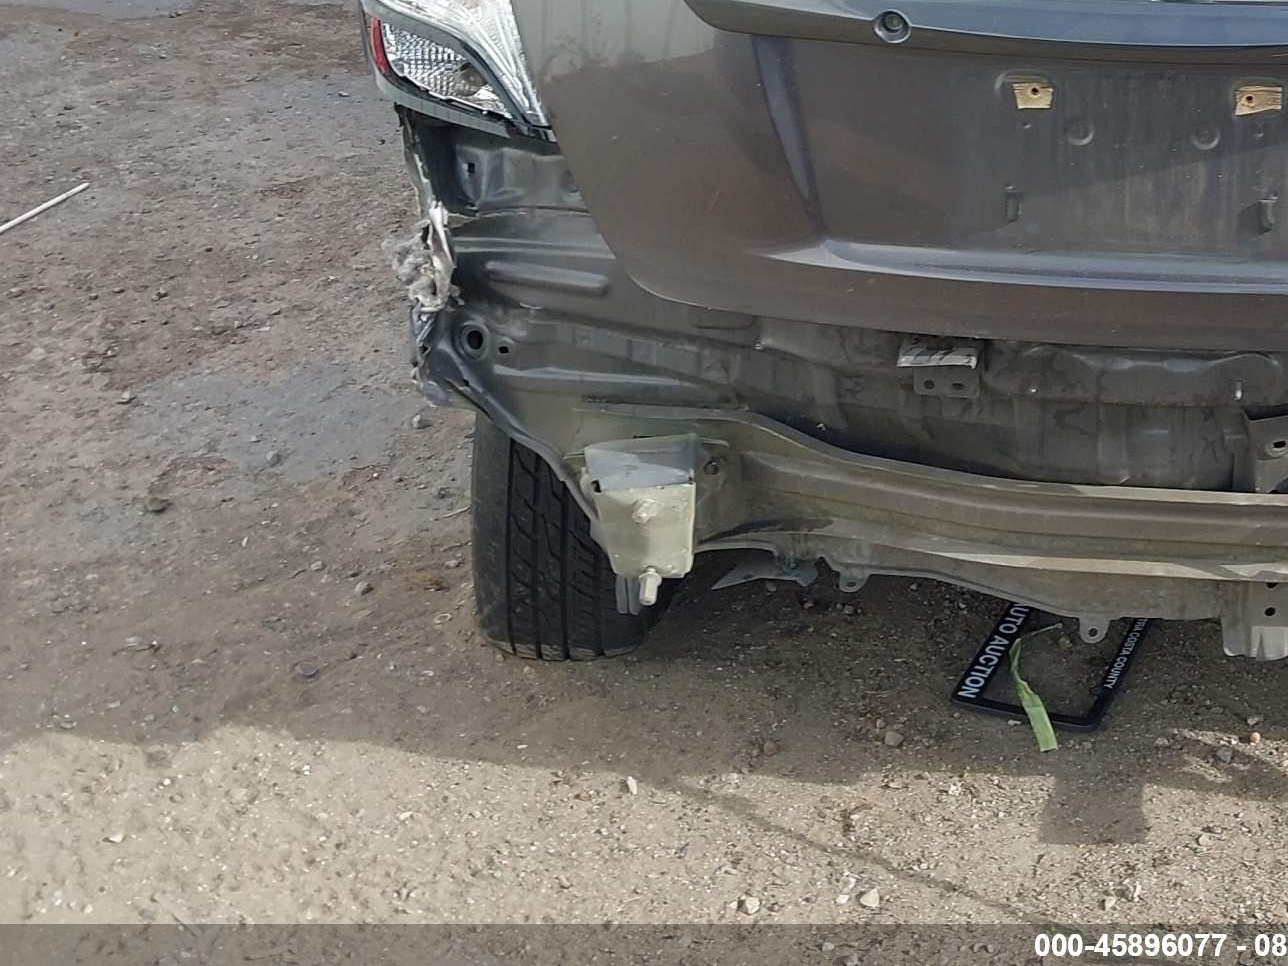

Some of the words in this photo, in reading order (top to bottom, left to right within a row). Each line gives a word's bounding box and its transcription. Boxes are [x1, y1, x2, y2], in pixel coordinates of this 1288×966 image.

[1120, 632, 1140, 655] COSTA
[957, 635, 1010, 699] AUCTION
[1103, 656, 1128, 689] COUNTY
